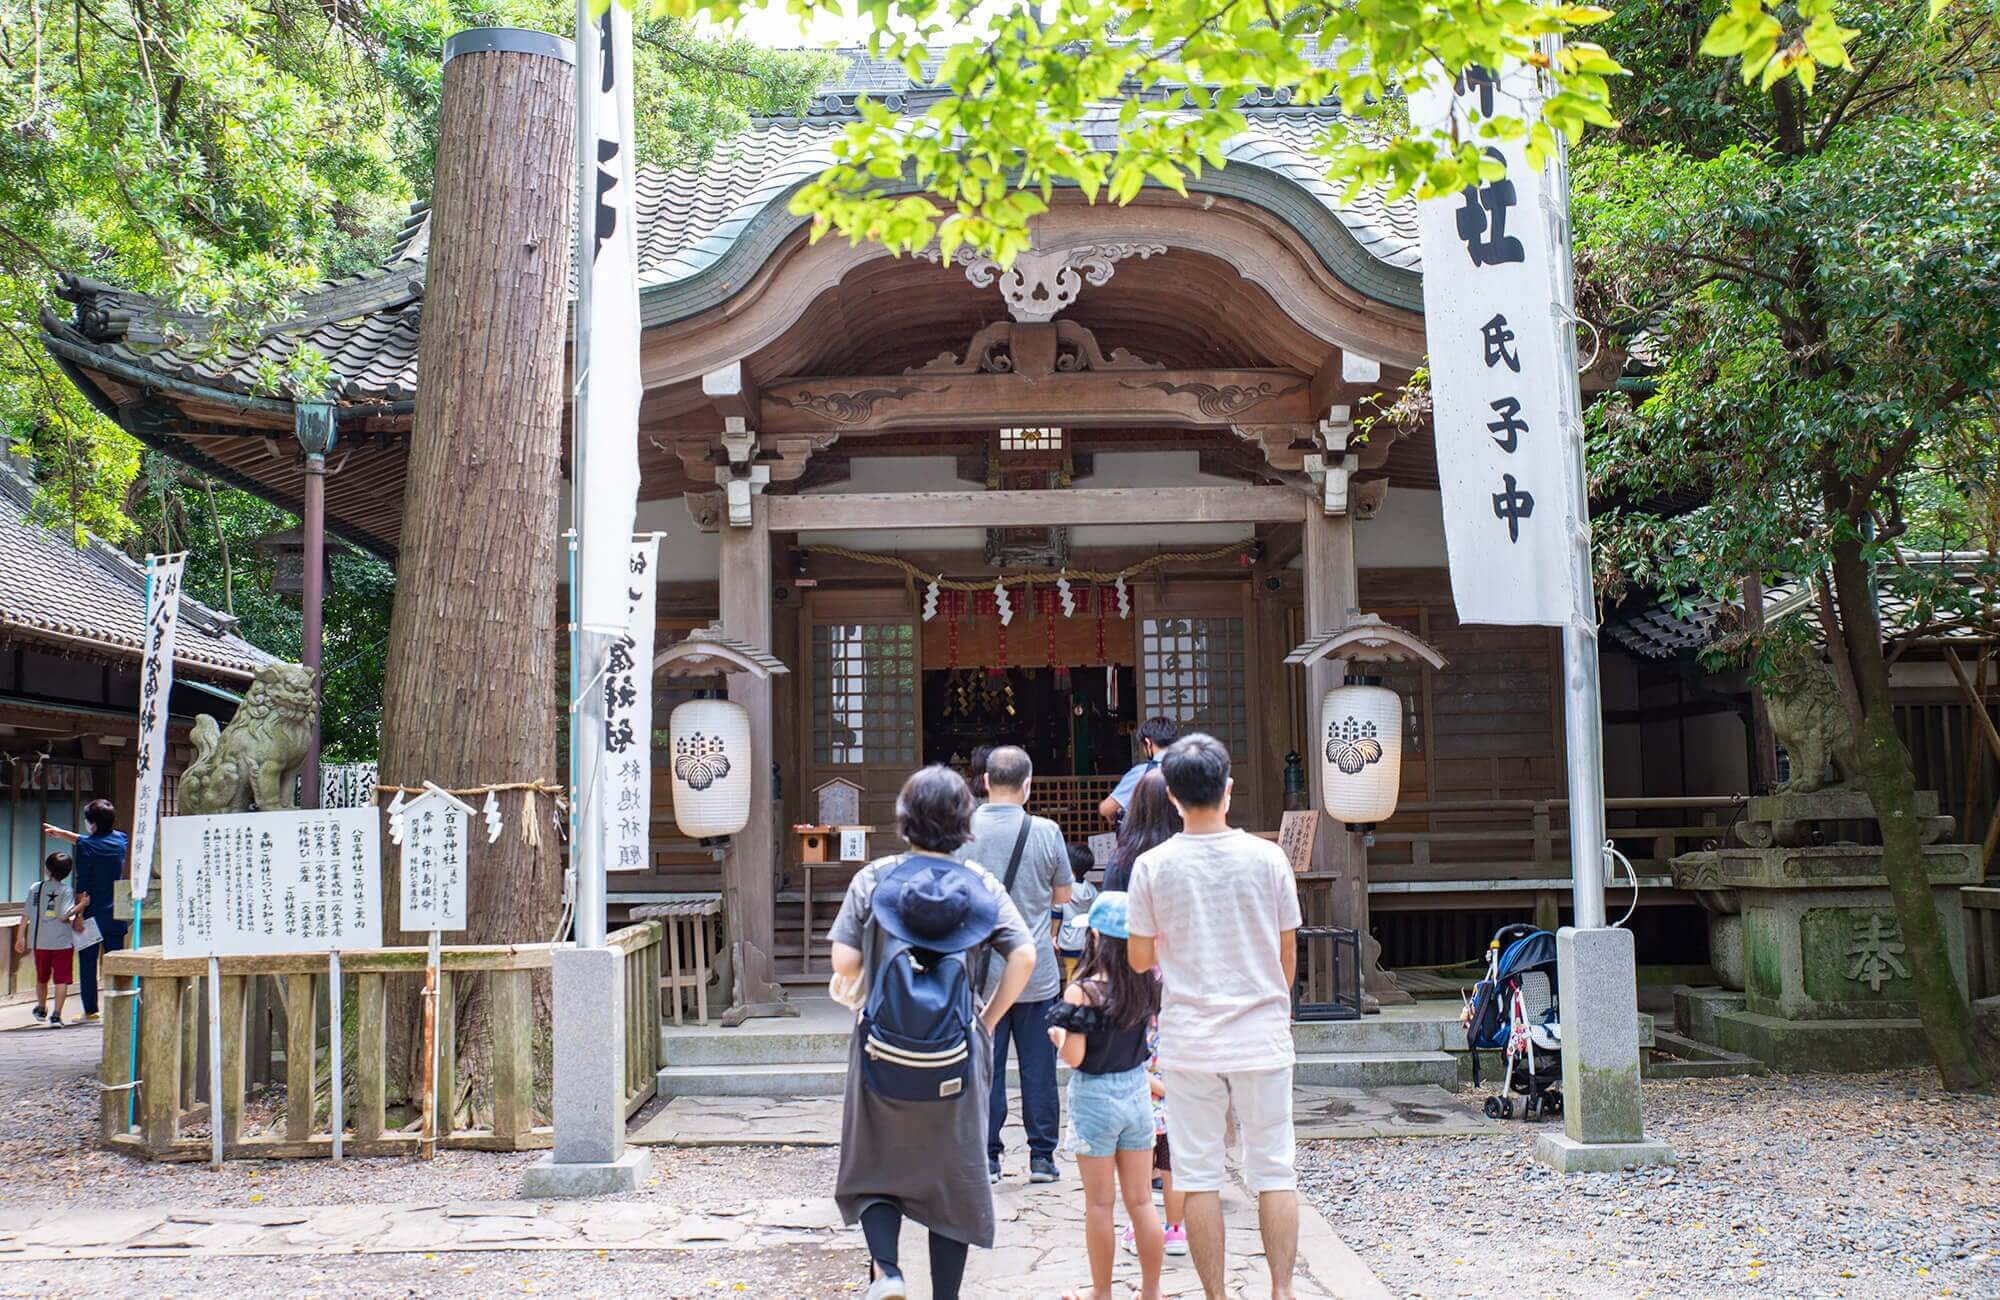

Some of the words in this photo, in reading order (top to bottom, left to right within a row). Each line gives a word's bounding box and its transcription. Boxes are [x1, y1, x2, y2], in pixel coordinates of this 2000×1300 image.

[1479, 312, 1536, 545] 氏子中
[442, 803, 459, 865] 八百富神社
